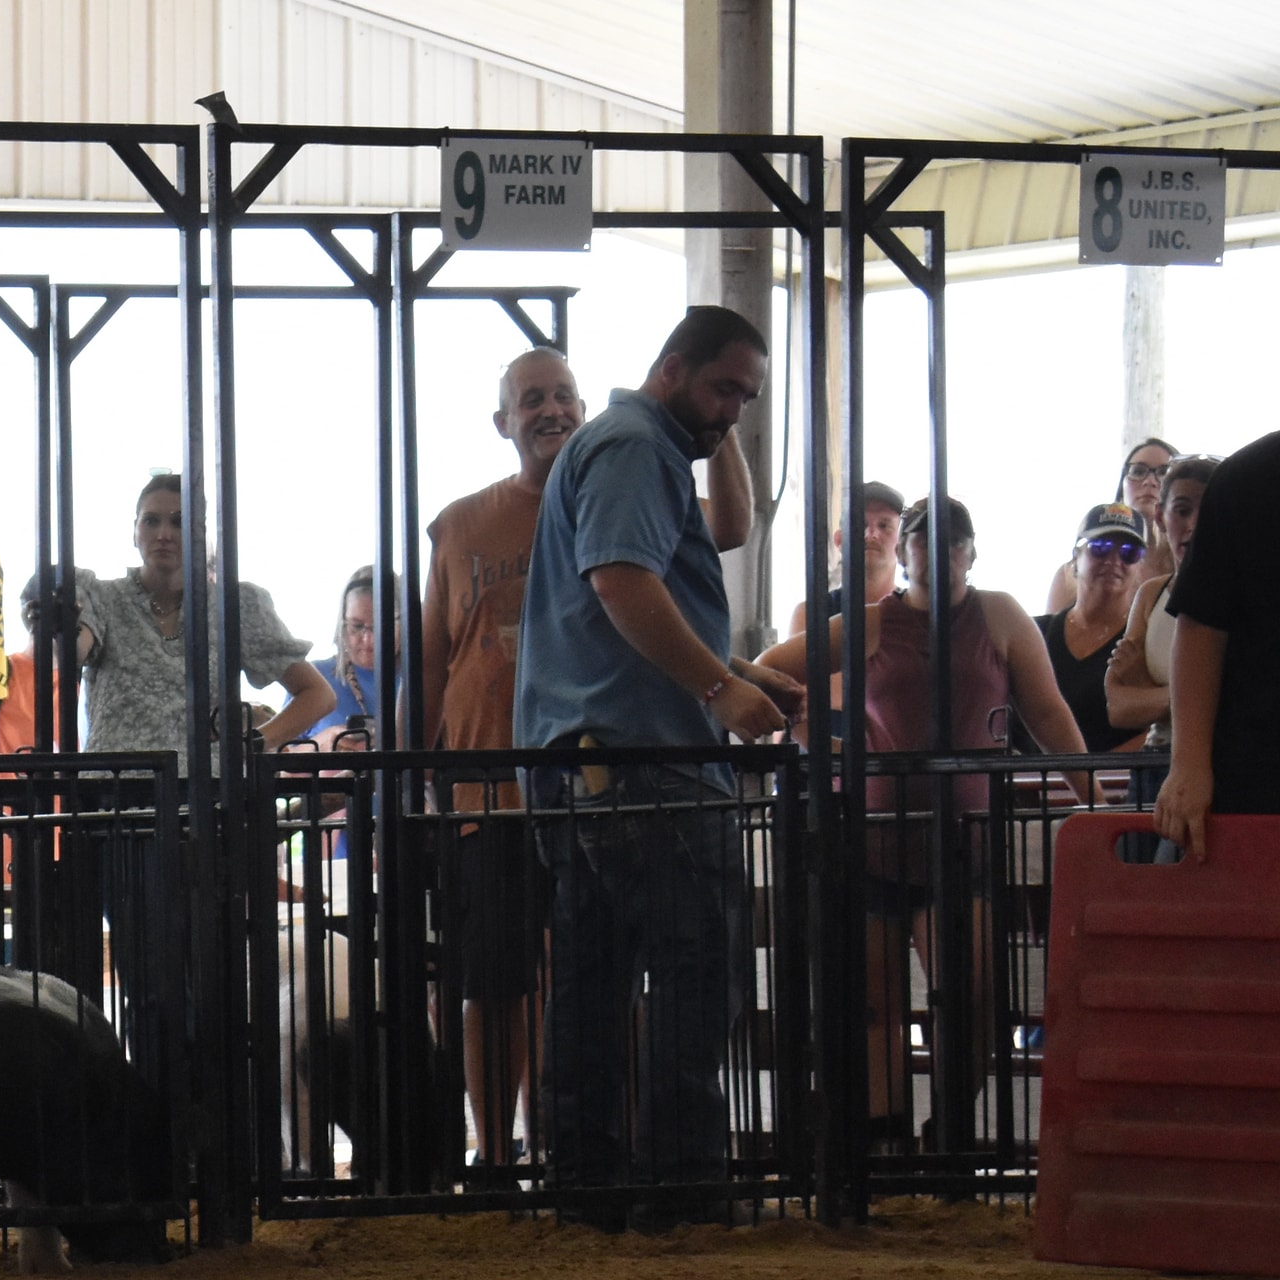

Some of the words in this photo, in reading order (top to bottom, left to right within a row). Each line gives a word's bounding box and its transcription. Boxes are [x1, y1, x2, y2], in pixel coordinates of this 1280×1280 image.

[488, 154, 555, 175] MARK
[561, 155, 582, 175] IV
[1141, 170, 1200, 192] J.B.S.
[453, 150, 486, 241] 9
[504, 184, 566, 205] FARM
[1092, 166, 1123, 253] 8
[1128, 198, 1213, 225] UNITED,
[1148, 229, 1191, 250] INC.
